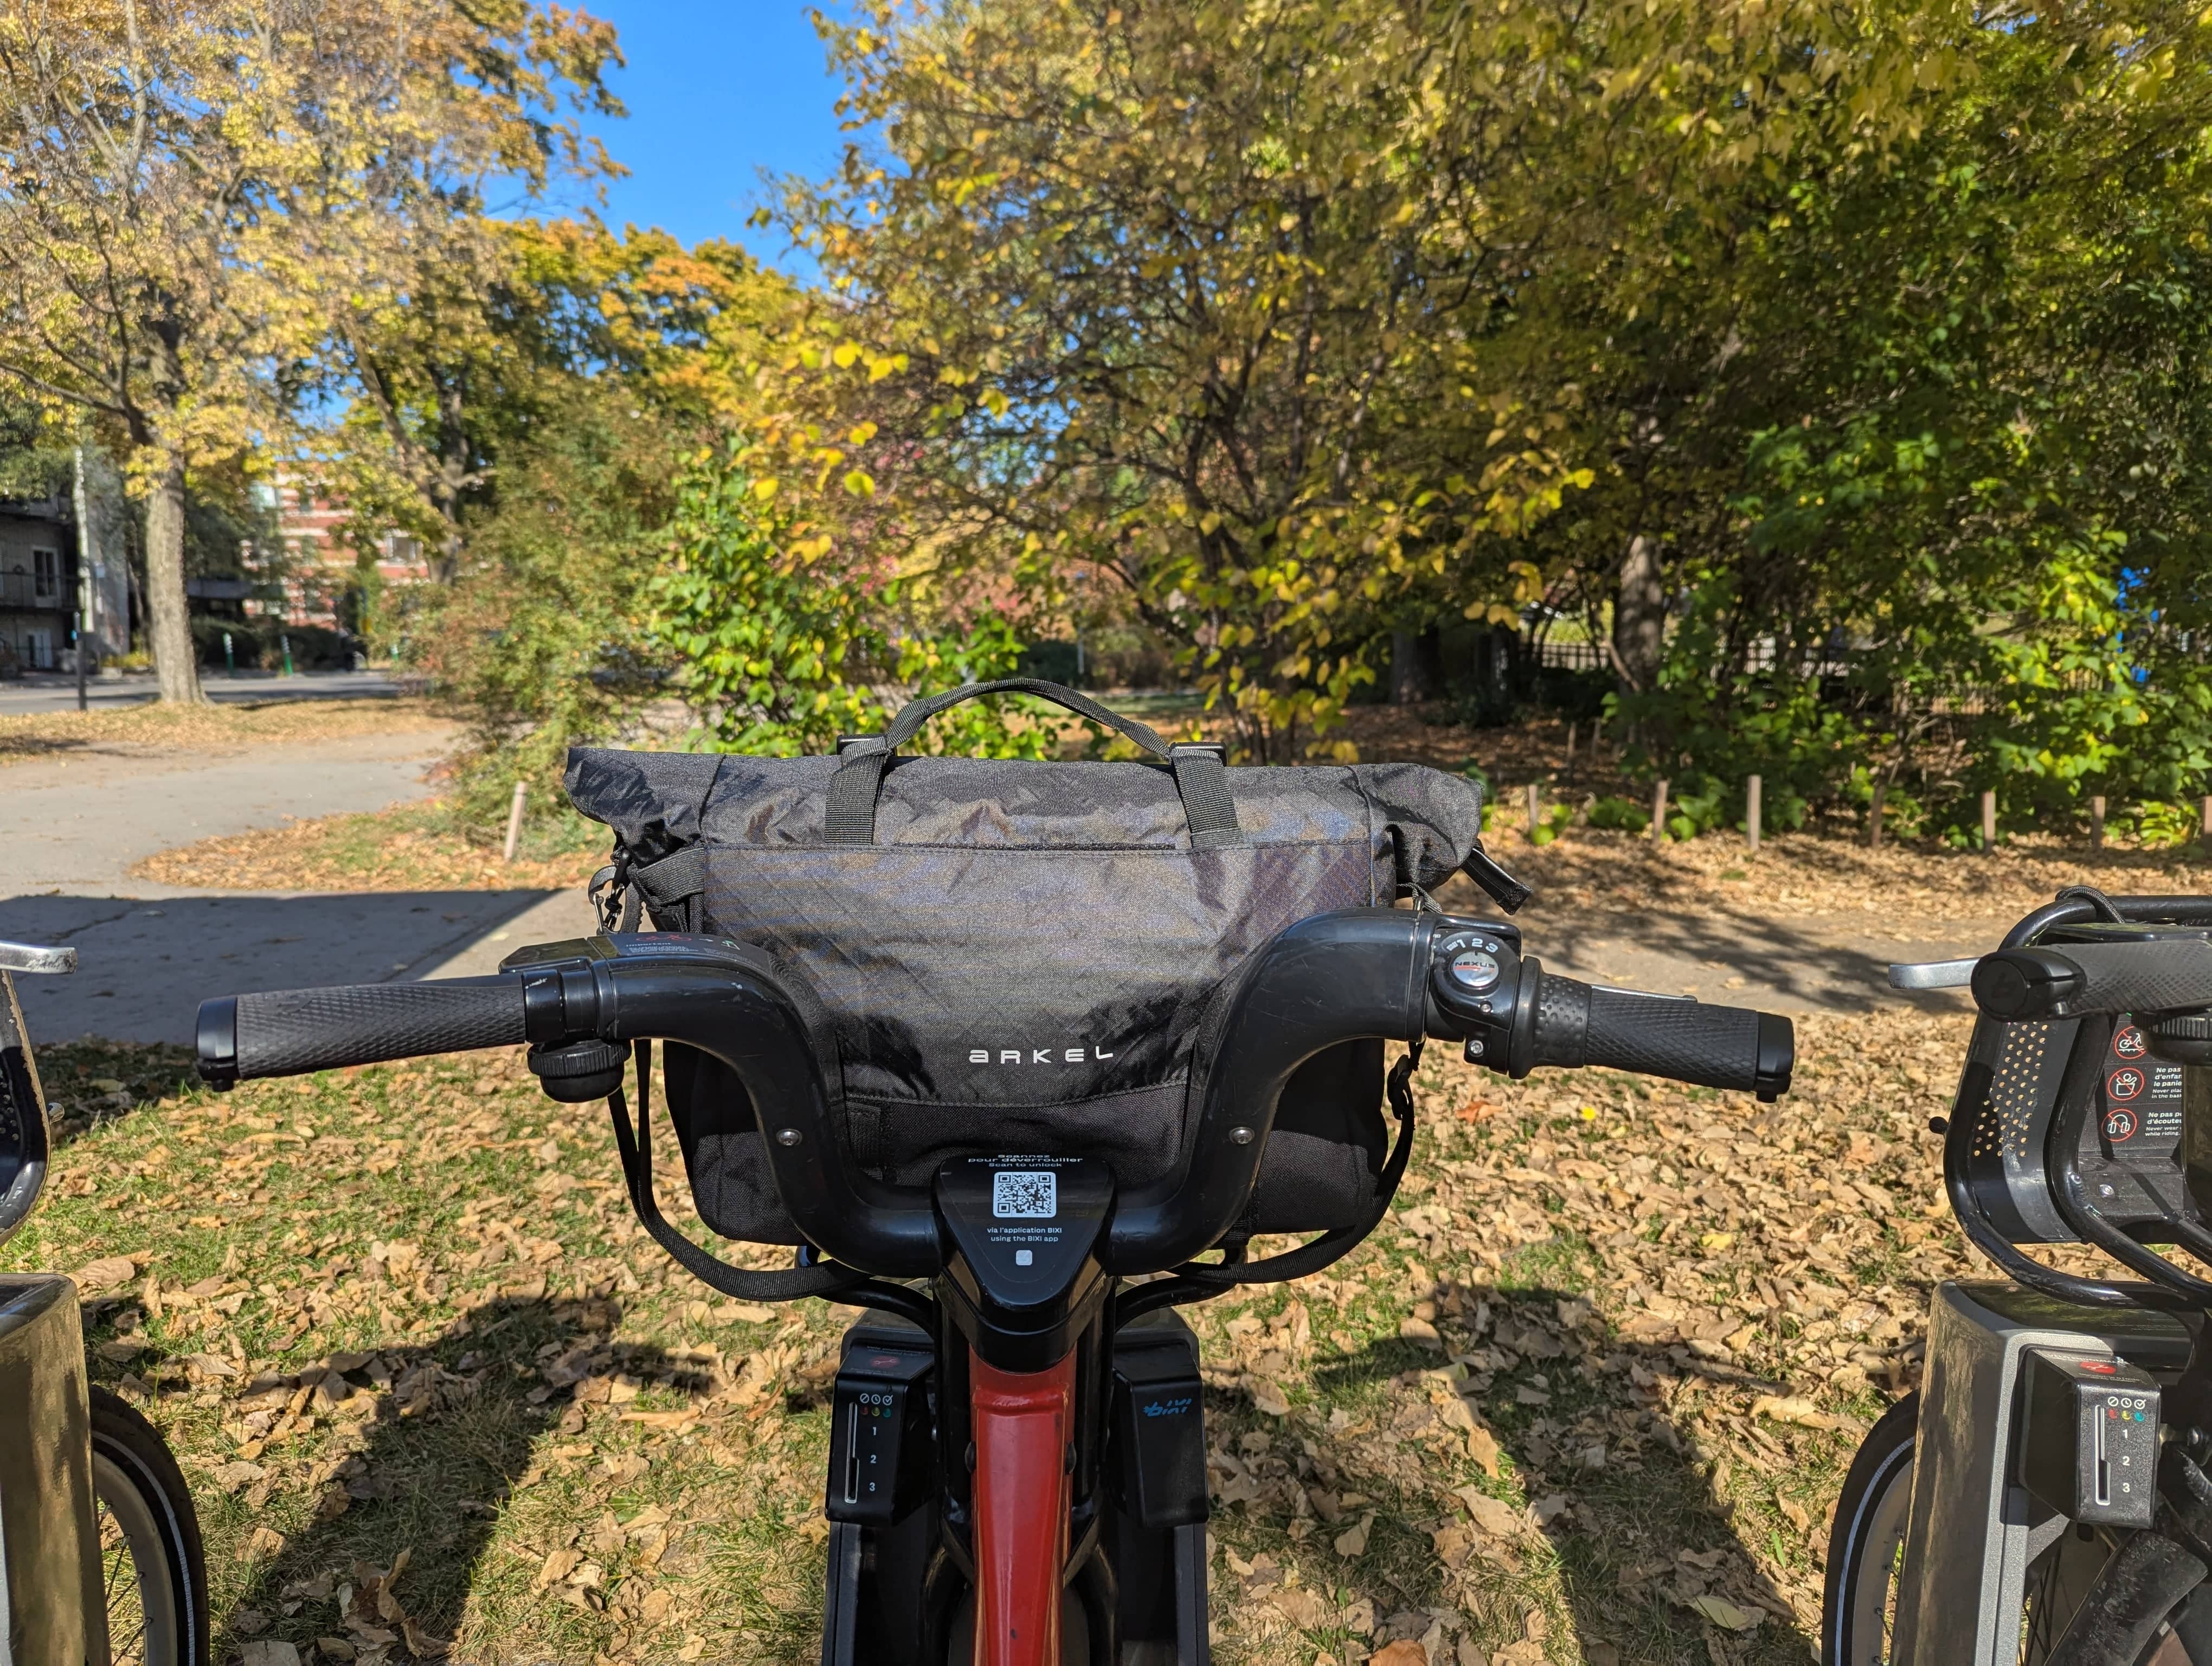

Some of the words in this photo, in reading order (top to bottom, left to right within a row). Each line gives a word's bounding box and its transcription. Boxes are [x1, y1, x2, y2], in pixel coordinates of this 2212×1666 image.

[1457, 939, 1466, 948] 1
[1471, 938, 1483, 948] 2
[1486, 943, 1499, 953] 3
[872, 1426, 877, 1436] 1
[2123, 1429, 2128, 1439] 1
[870, 1454, 877, 1464] 2
[2123, 1456, 2130, 1466] 2
[869, 1482, 876, 1491] 3
[2123, 1483, 2130, 1493] 3
